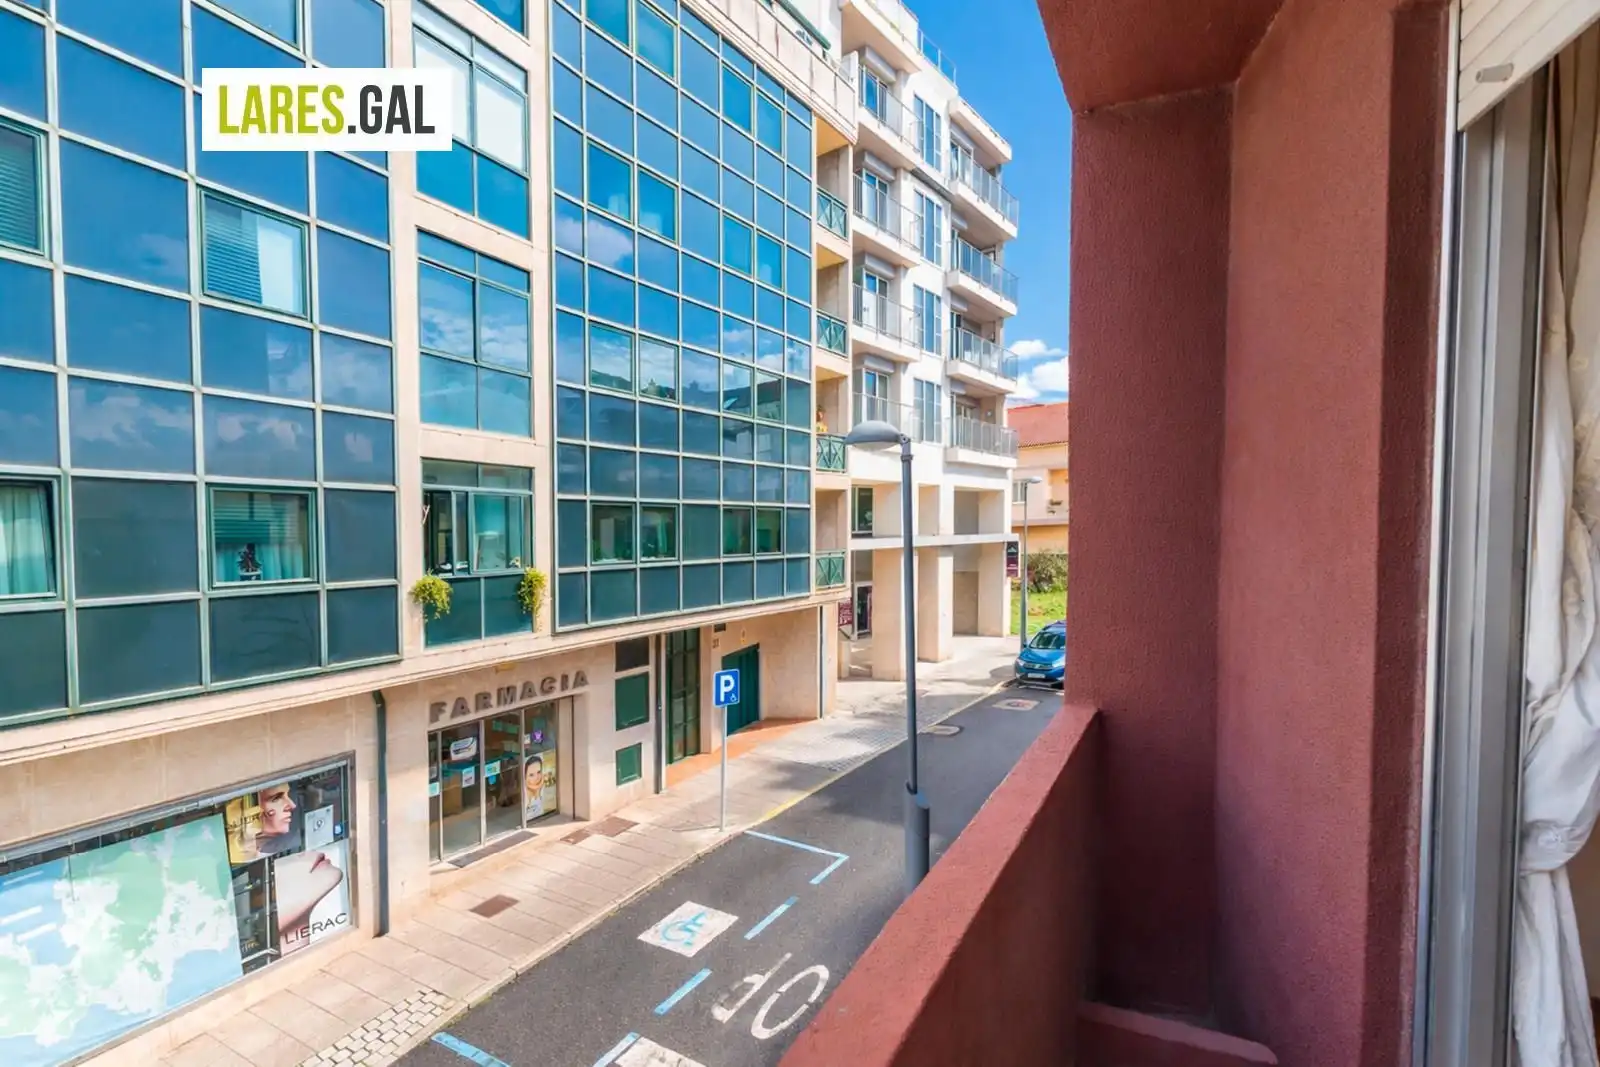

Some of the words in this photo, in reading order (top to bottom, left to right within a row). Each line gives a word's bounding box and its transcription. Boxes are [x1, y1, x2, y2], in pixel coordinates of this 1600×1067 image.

[430, 670, 589, 724] FARMACIA
[719, 674, 735, 702] P
[284, 912, 347, 945] LIERAC
